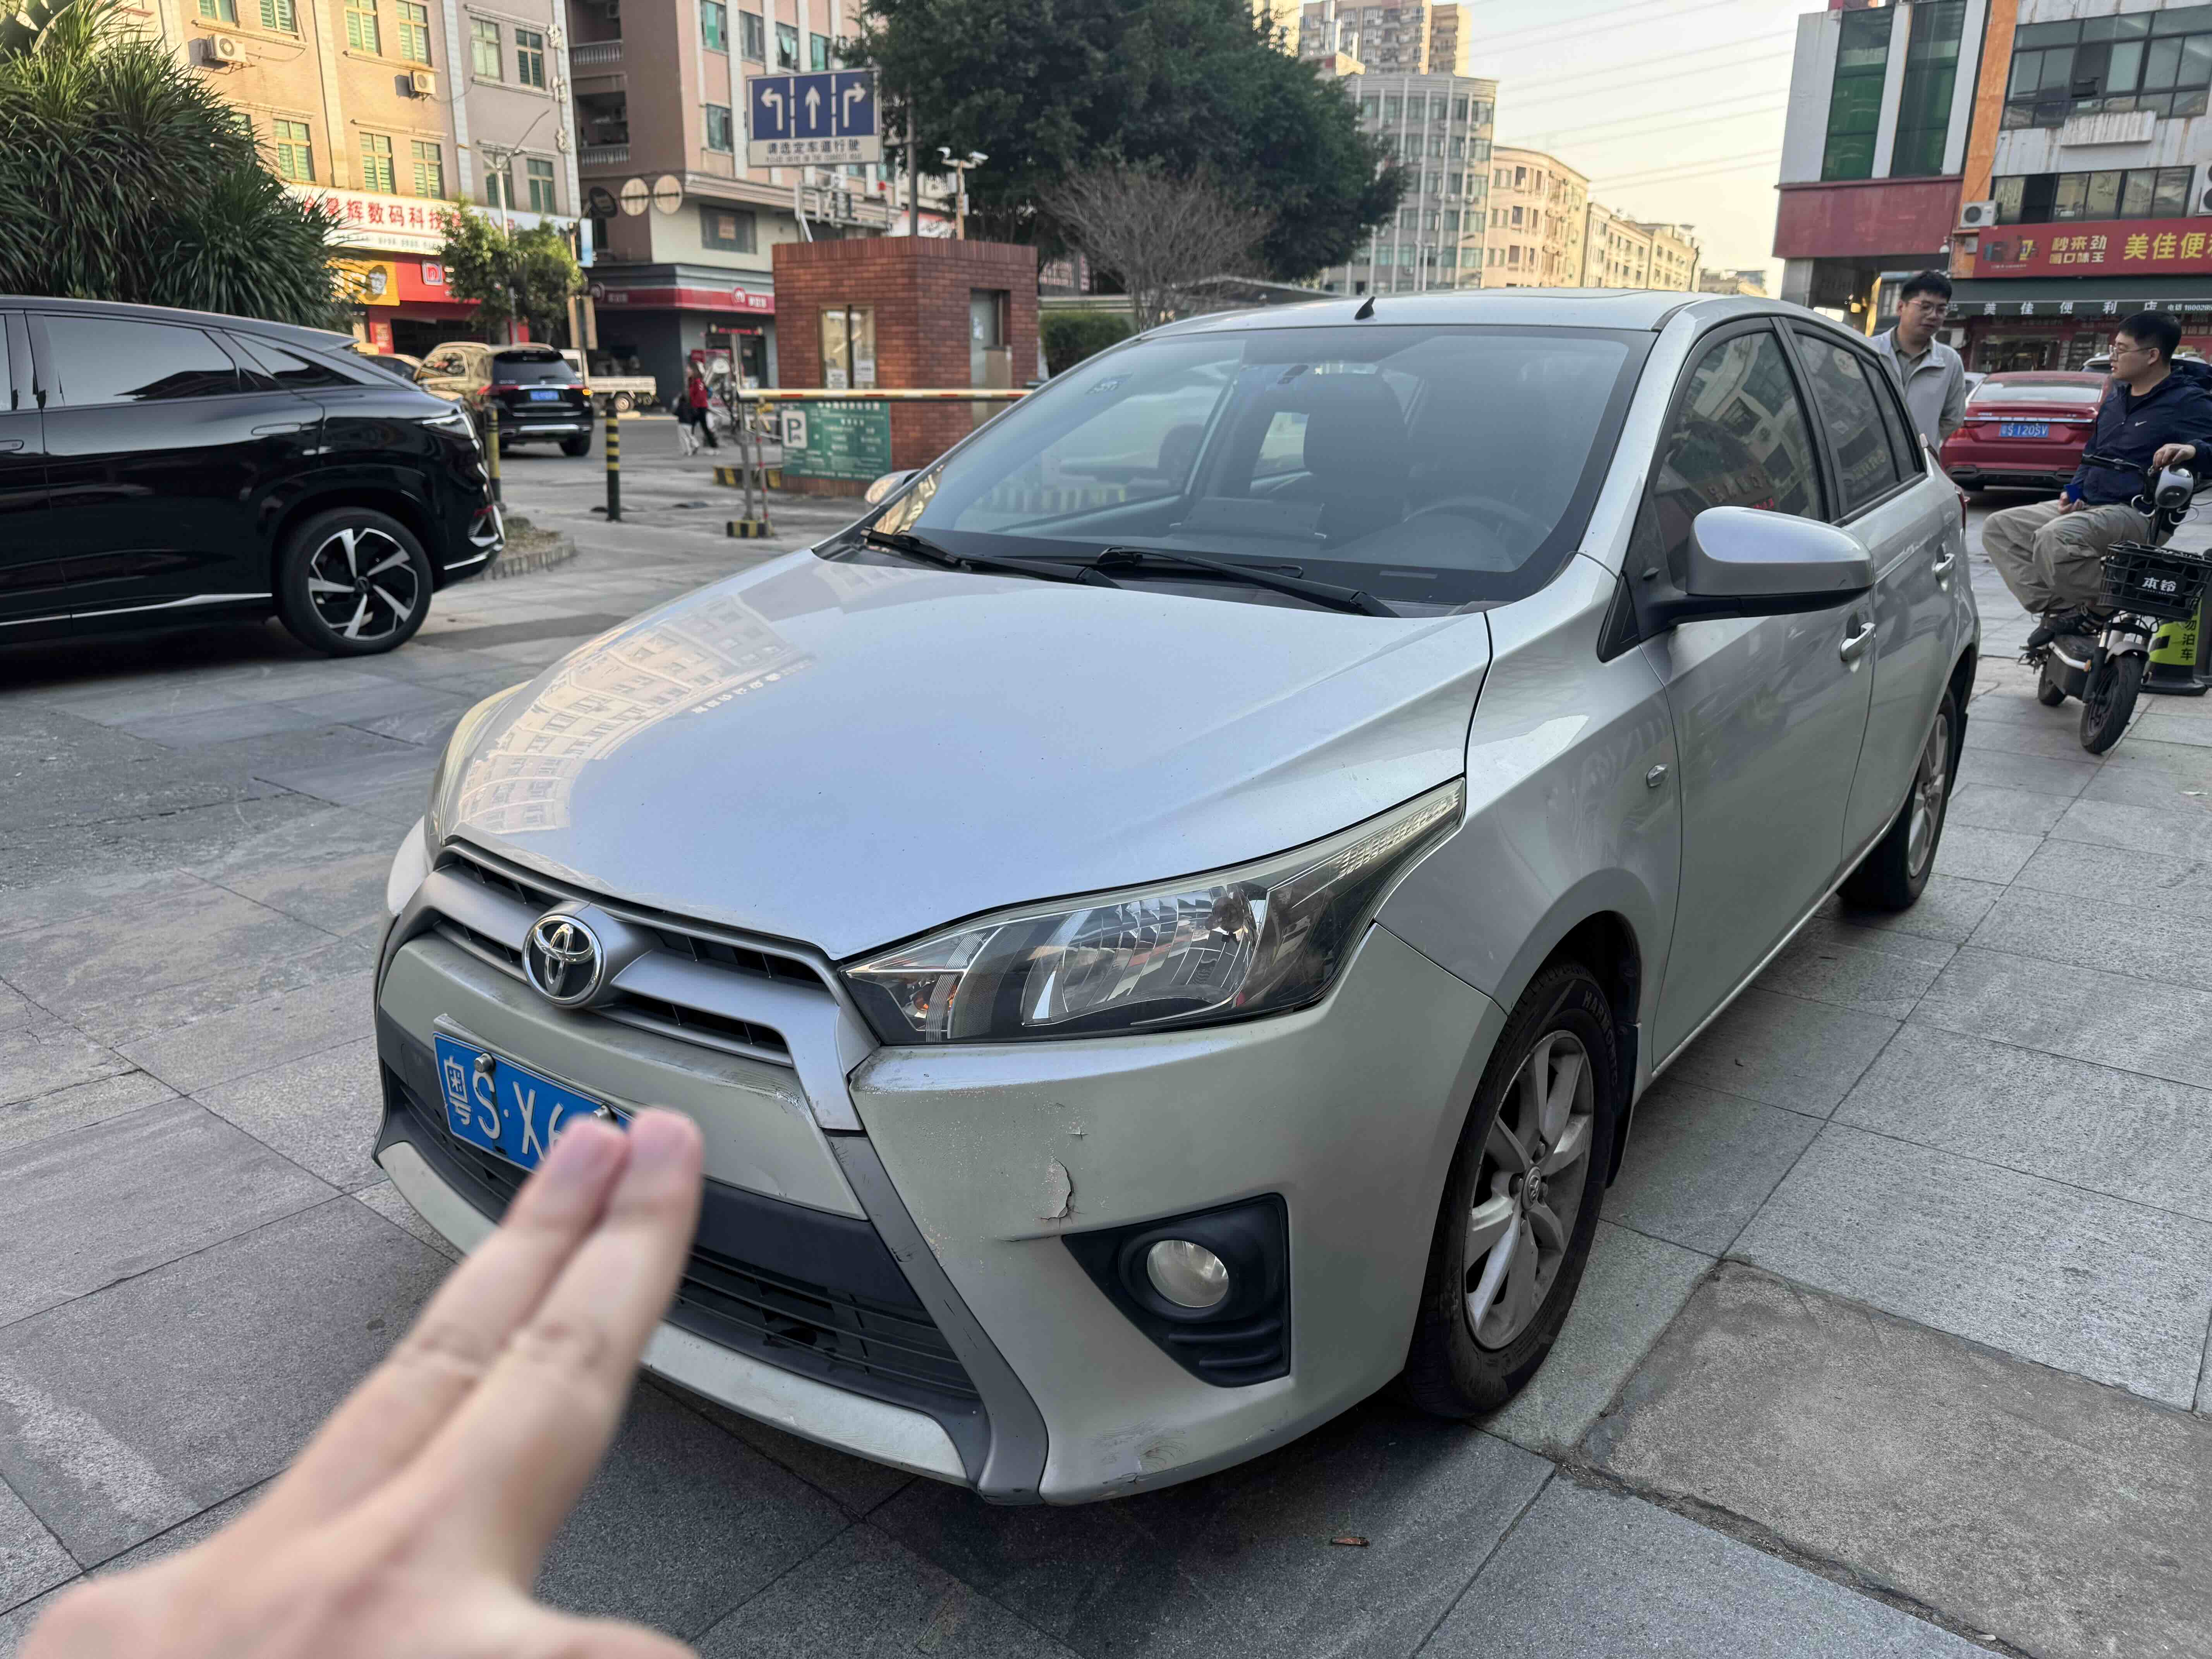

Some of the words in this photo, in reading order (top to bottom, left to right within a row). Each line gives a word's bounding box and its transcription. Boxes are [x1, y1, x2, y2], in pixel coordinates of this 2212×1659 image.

[2123, 232, 2212, 260] 美佳便
[2142, 577, 2177, 592] 本铃
[2180, 602, 2198, 661] 勿泊车
